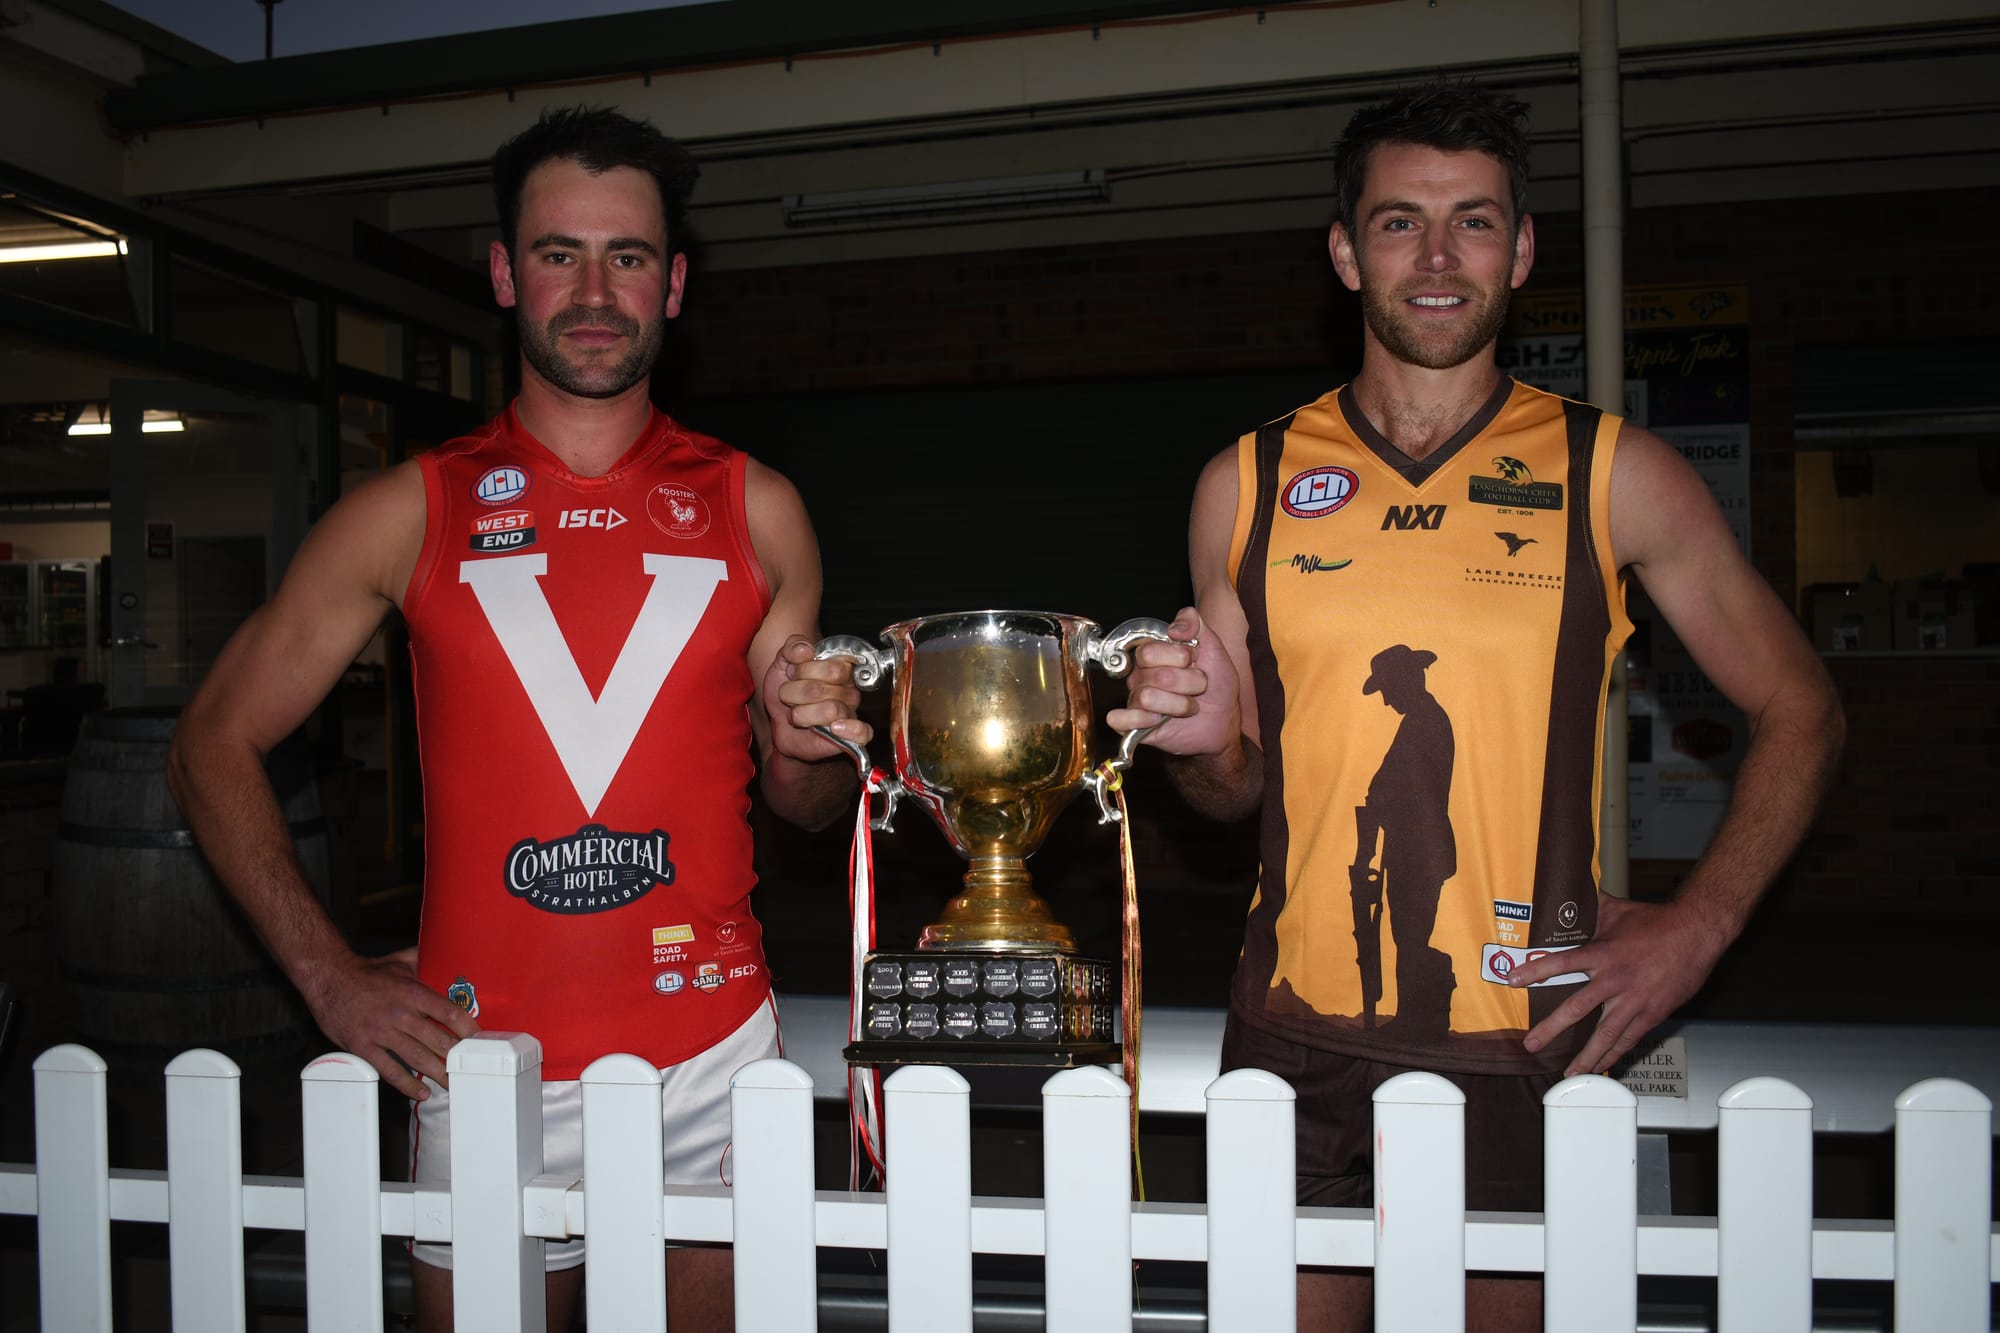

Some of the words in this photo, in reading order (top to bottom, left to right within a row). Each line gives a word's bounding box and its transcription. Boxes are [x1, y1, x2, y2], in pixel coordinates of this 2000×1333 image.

[658, 487, 696, 499] ROOSTERS
[1474, 483, 1528, 495] LANGHORNE
[1530, 488, 1558, 497] CREEK
[1483, 493, 1525, 503] FOOTBALL
[1528, 497, 1551, 505] CLUB
[1289, 507, 1318, 517] FOOTBALL
[1319, 500, 1346, 515] LEAGUE
[476, 513, 530, 532] WEST
[1380, 505, 1448, 530] NXI
[482, 532, 524, 548] END
[1291, 553, 1327, 573] Milk
[1466, 568, 1502, 576] LAKE
[1508, 571, 1562, 582] BREEZE
[459, 553, 728, 819] V
[510, 835, 670, 891] COMMERCIAL
[563, 869, 618, 892] HOTEL
[531, 876, 652, 908] STRATHALBYN
[1495, 904, 1527, 917] THINK!
[653, 945, 681, 956] ROAD
[653, 953, 688, 964] SAFETY
[692, 974, 726, 988] SANFL
[1653, 1071, 1683, 1080] CREEK
[1648, 1083, 1677, 1093] PARK
